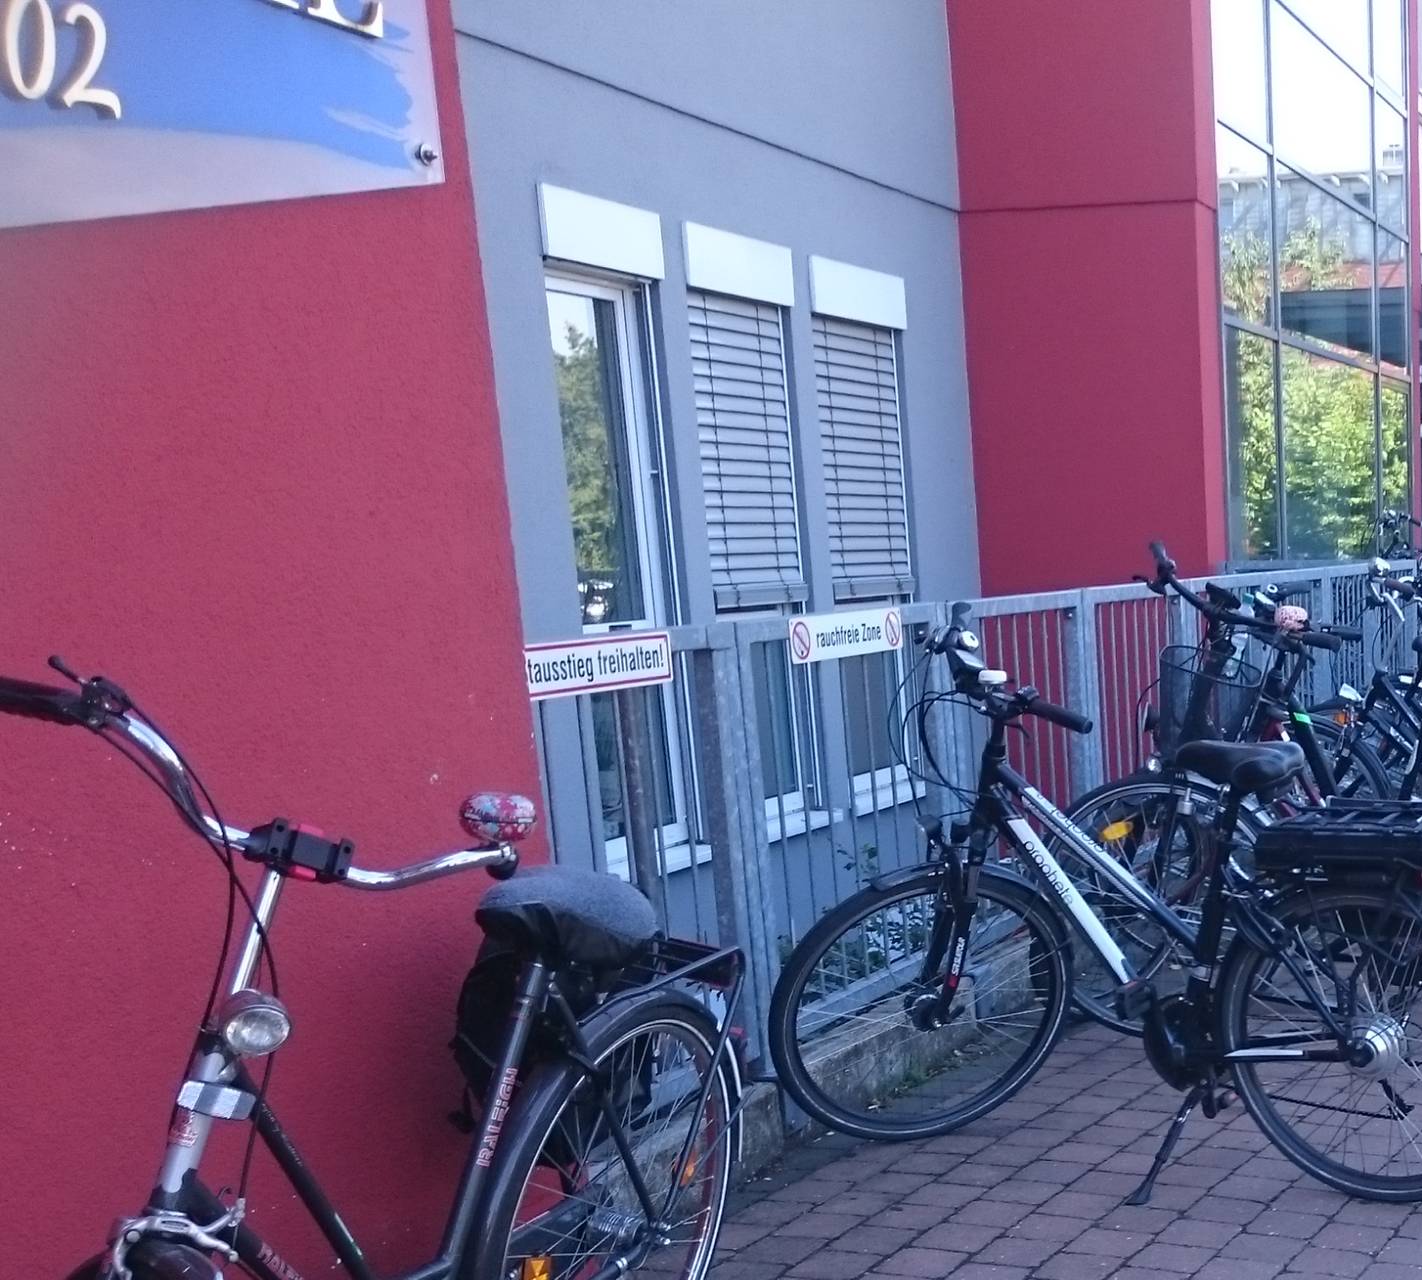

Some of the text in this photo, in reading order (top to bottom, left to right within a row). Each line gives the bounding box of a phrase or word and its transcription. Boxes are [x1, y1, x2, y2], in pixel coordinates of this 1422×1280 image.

[816, 625, 881, 649] rauchfreie Zone
[597, 644, 665, 677] freihalten!
[475, 1067, 519, 1168] RALEIGH
